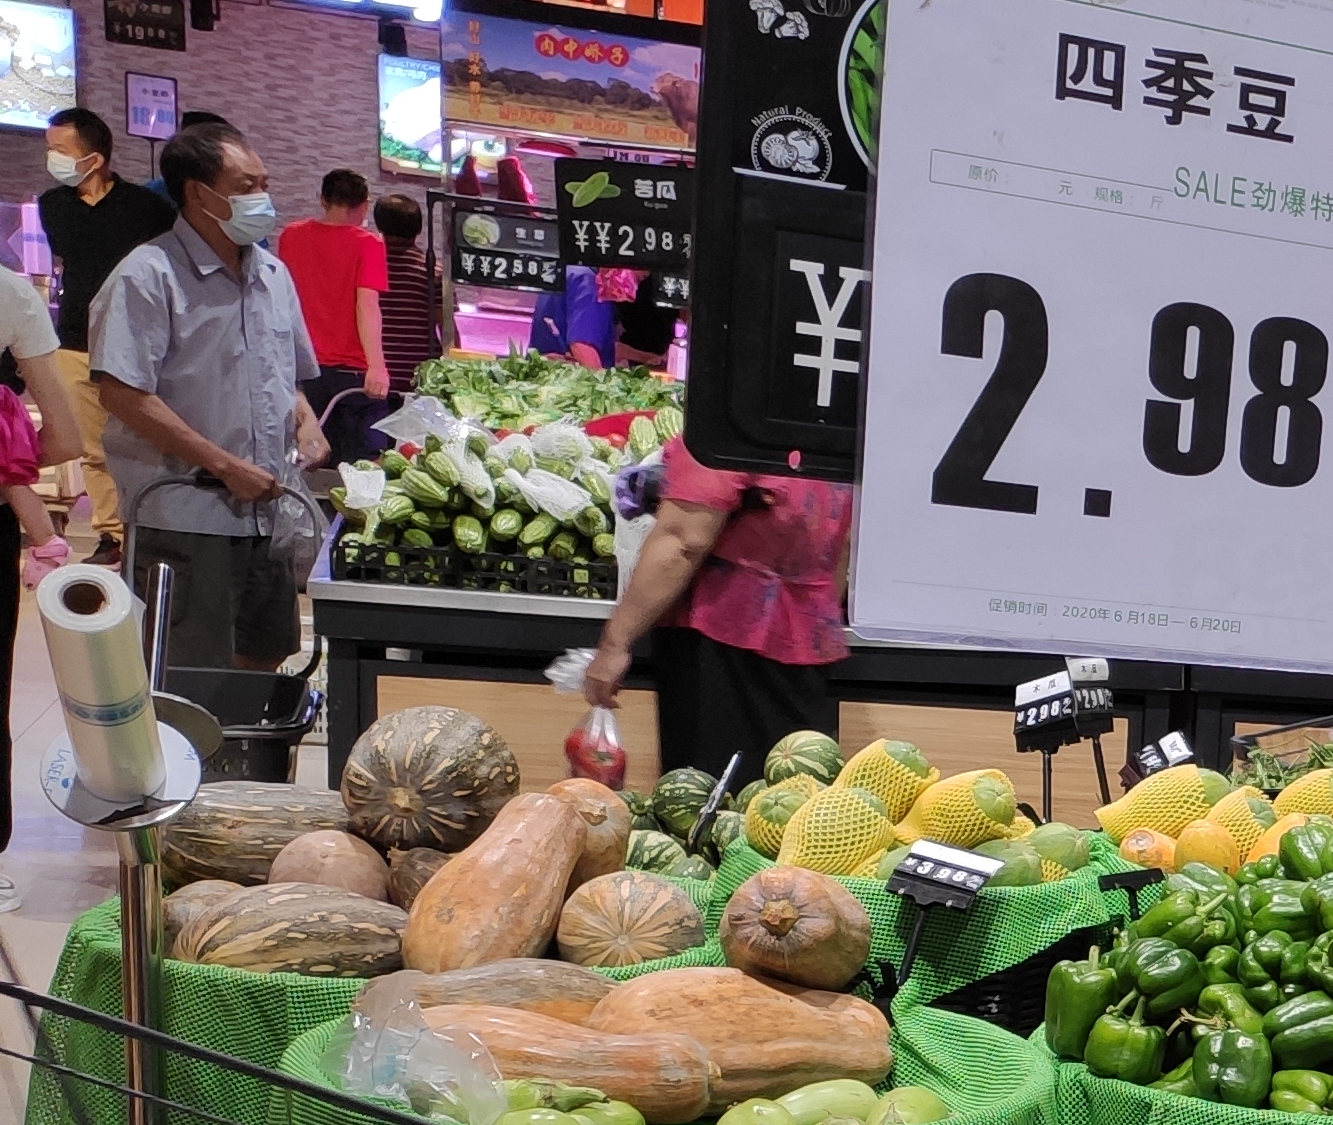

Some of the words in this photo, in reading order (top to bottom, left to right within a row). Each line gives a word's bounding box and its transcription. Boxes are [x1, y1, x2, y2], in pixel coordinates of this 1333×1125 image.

[1055, 32, 1296, 144] 四季豆
[751, 105, 790, 128] Natural
[795, 106, 833, 139] Product
[633, 178, 677, 200] 苦瓜
[572, 219, 673, 257] ¥¥2.98
[931, 272, 1330, 519] 2.98
[1032, 679, 1056, 693] 木瓜
